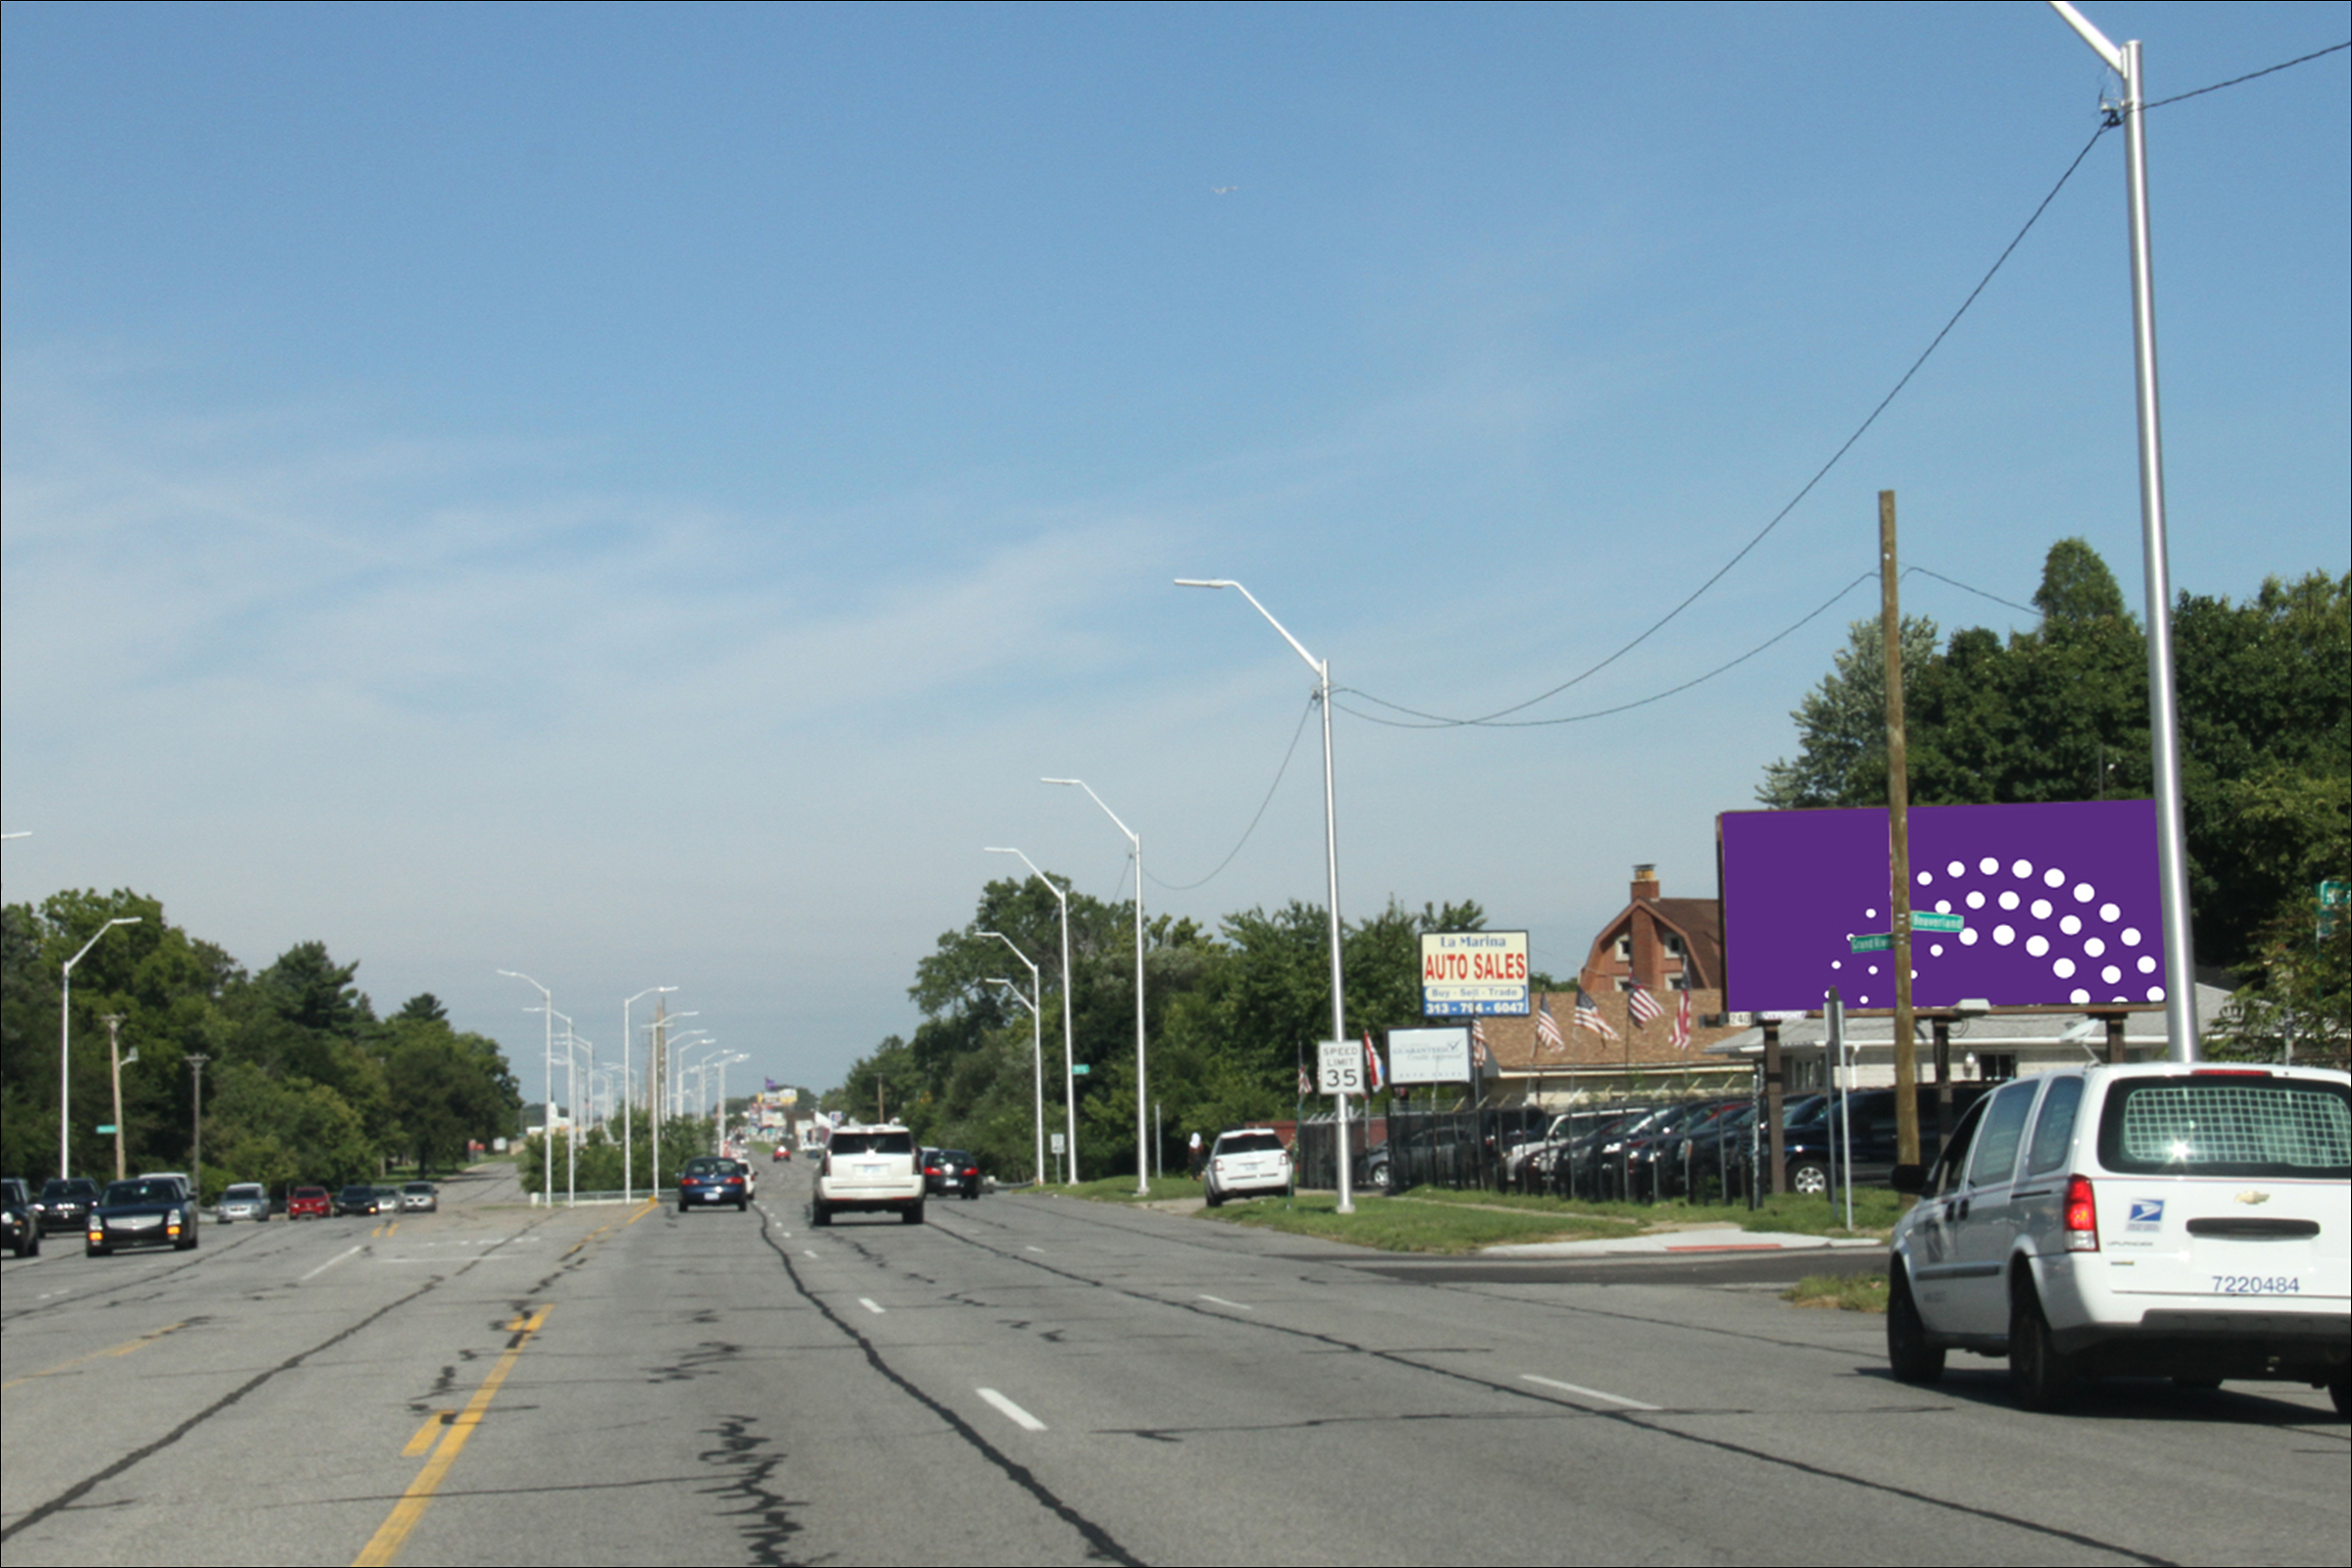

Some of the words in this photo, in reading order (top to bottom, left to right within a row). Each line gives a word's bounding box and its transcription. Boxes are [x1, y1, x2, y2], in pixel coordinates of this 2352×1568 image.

[1441, 936, 1455, 948] La
[1460, 936, 1506, 948] Marina
[1424, 954, 1468, 980] AUTO
[1473, 953, 1526, 980] SALES
[1432, 988, 1450, 999] Buy
[1460, 988, 1479, 997] Sell
[1489, 988, 1517, 997] Trade
[1326, 1069, 1357, 1087] 35
[2212, 1276, 2300, 1293] 7220484
